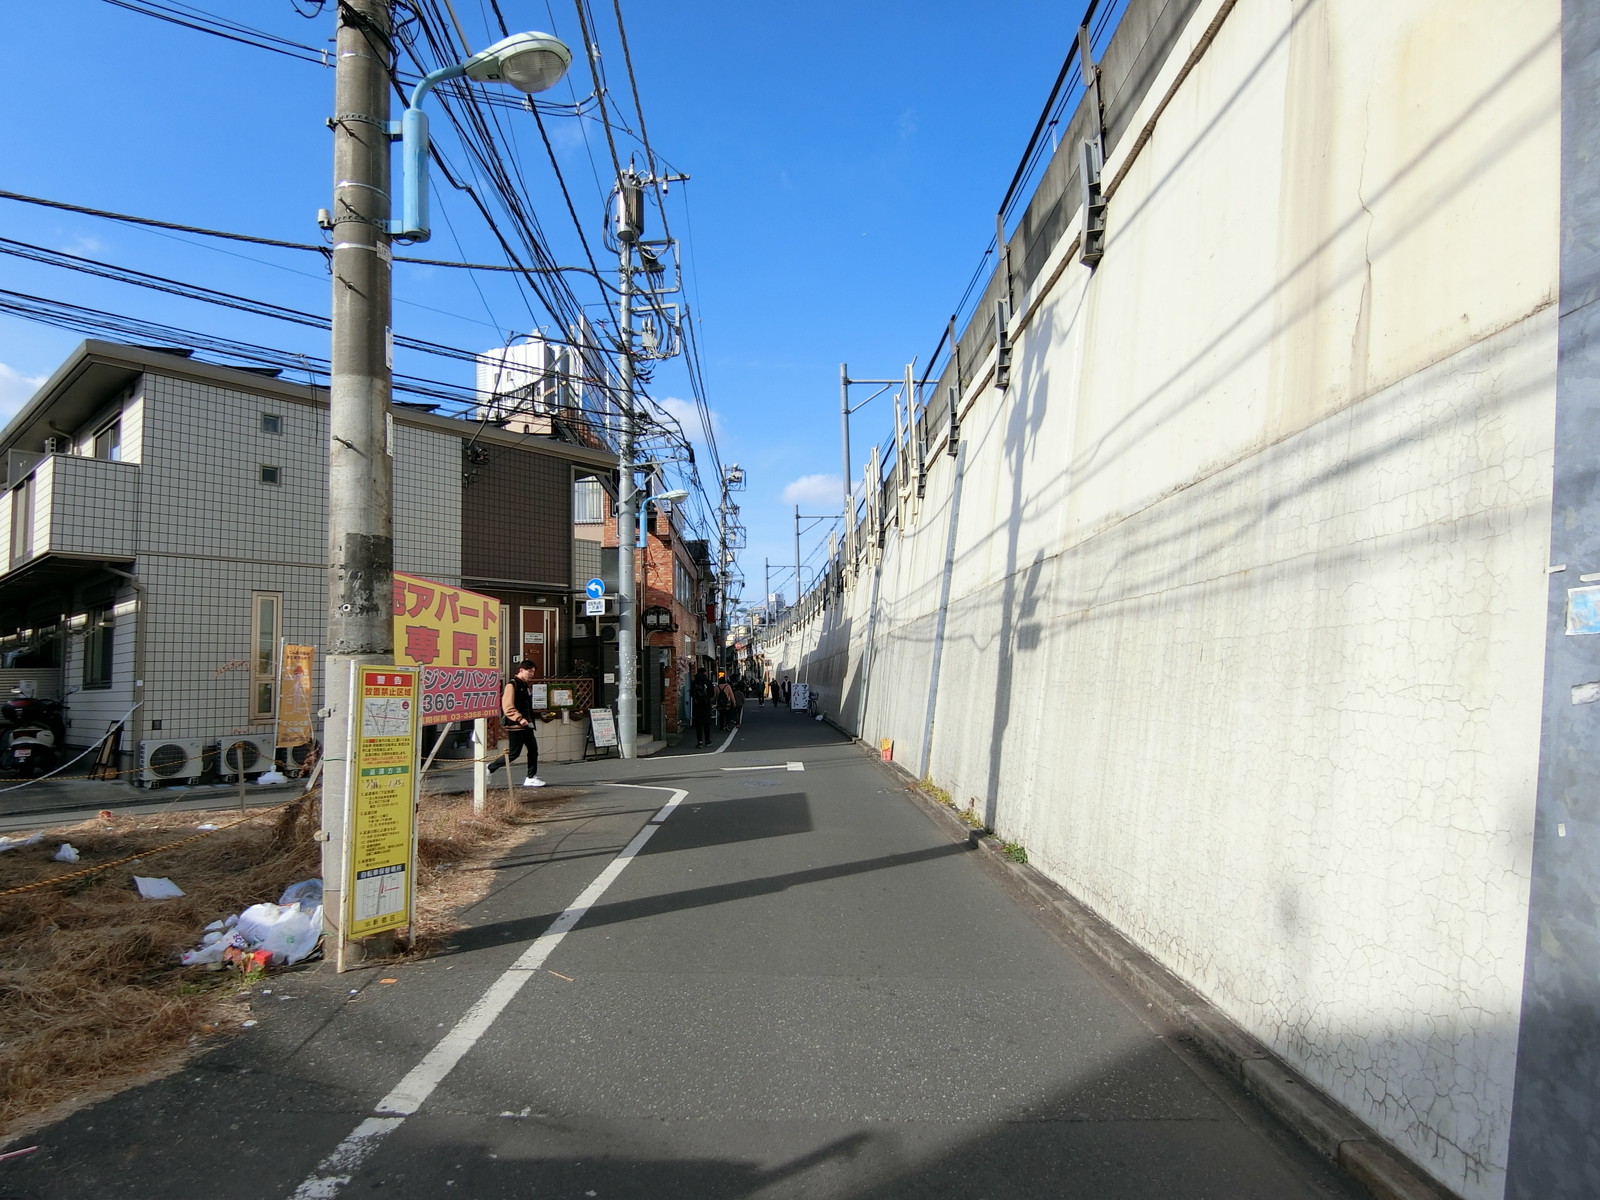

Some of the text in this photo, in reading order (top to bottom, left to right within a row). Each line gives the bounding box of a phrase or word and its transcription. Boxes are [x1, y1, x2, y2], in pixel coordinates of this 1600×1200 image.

[405, 625, 478, 666] 専門
[489, 636, 497, 667] 新宿店
